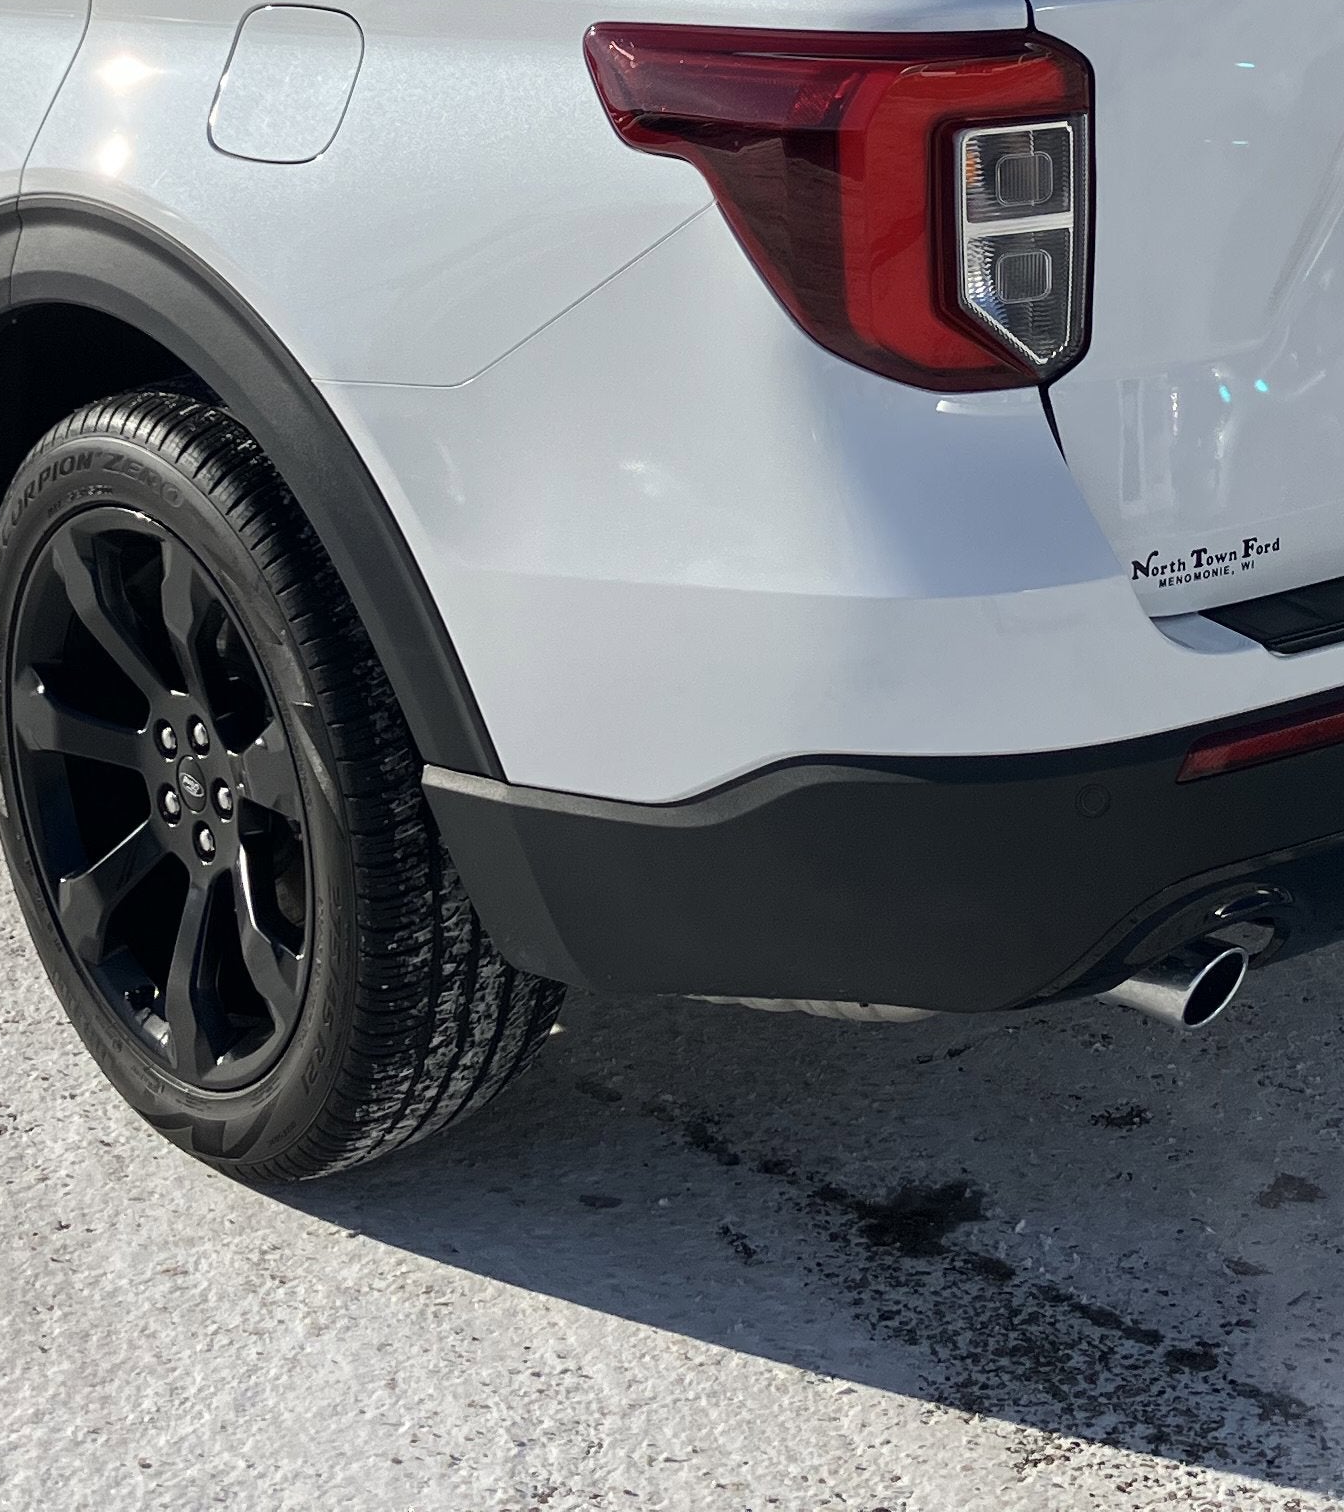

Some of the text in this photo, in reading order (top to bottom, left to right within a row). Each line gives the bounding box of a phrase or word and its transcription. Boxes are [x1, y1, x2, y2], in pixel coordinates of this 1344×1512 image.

[1131, 537, 1280, 580] North Town Ford
[1158, 560, 1255, 588] MENOMONIE, WI
